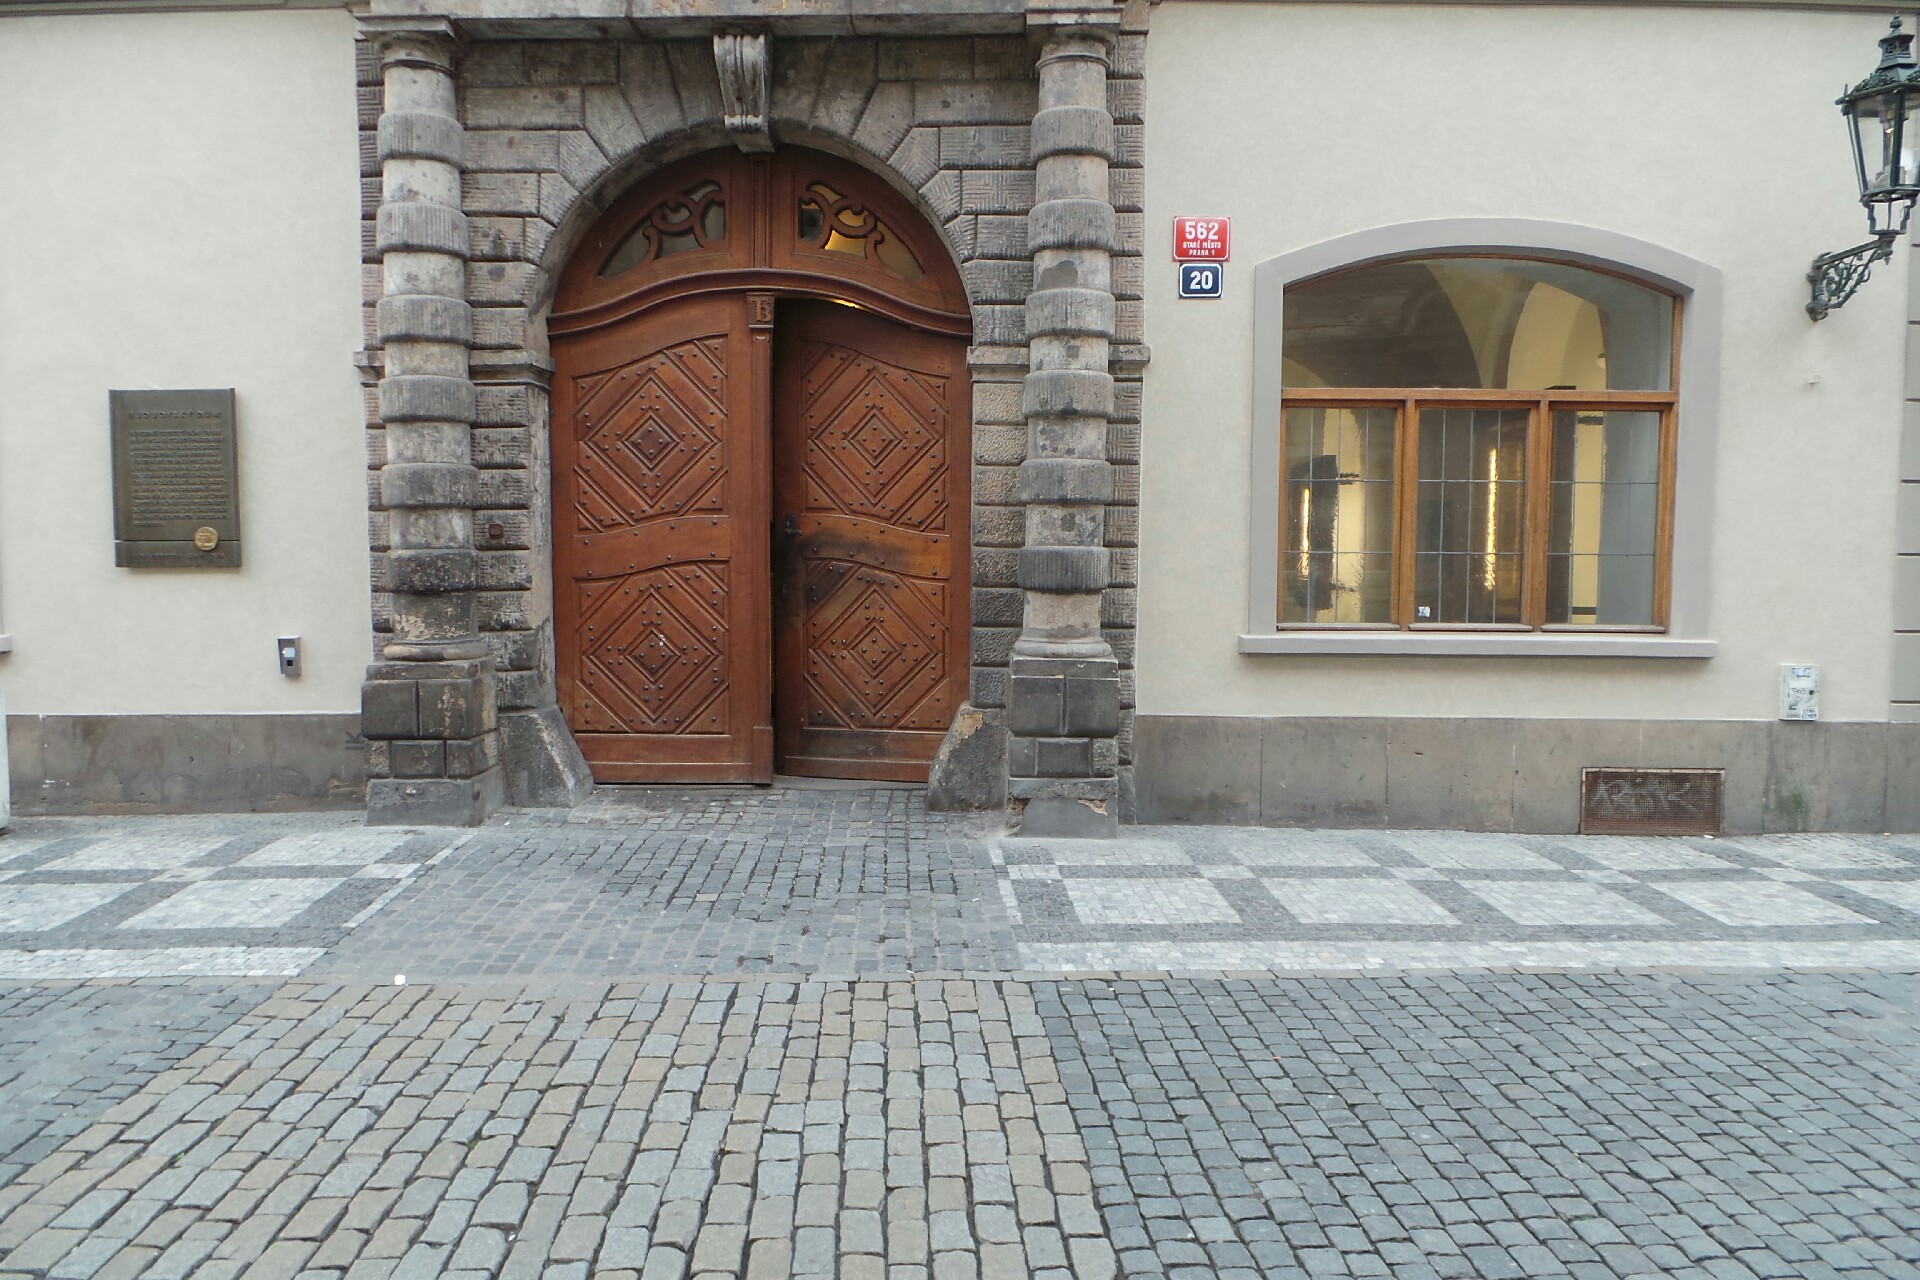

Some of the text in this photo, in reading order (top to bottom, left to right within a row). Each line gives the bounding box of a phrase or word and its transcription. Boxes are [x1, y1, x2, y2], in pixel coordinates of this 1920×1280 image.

[1185, 221, 1219, 240] 562
[1183, 240, 1221, 249] STARÉ MĚSTO
[1190, 270, 1213, 290] 20
